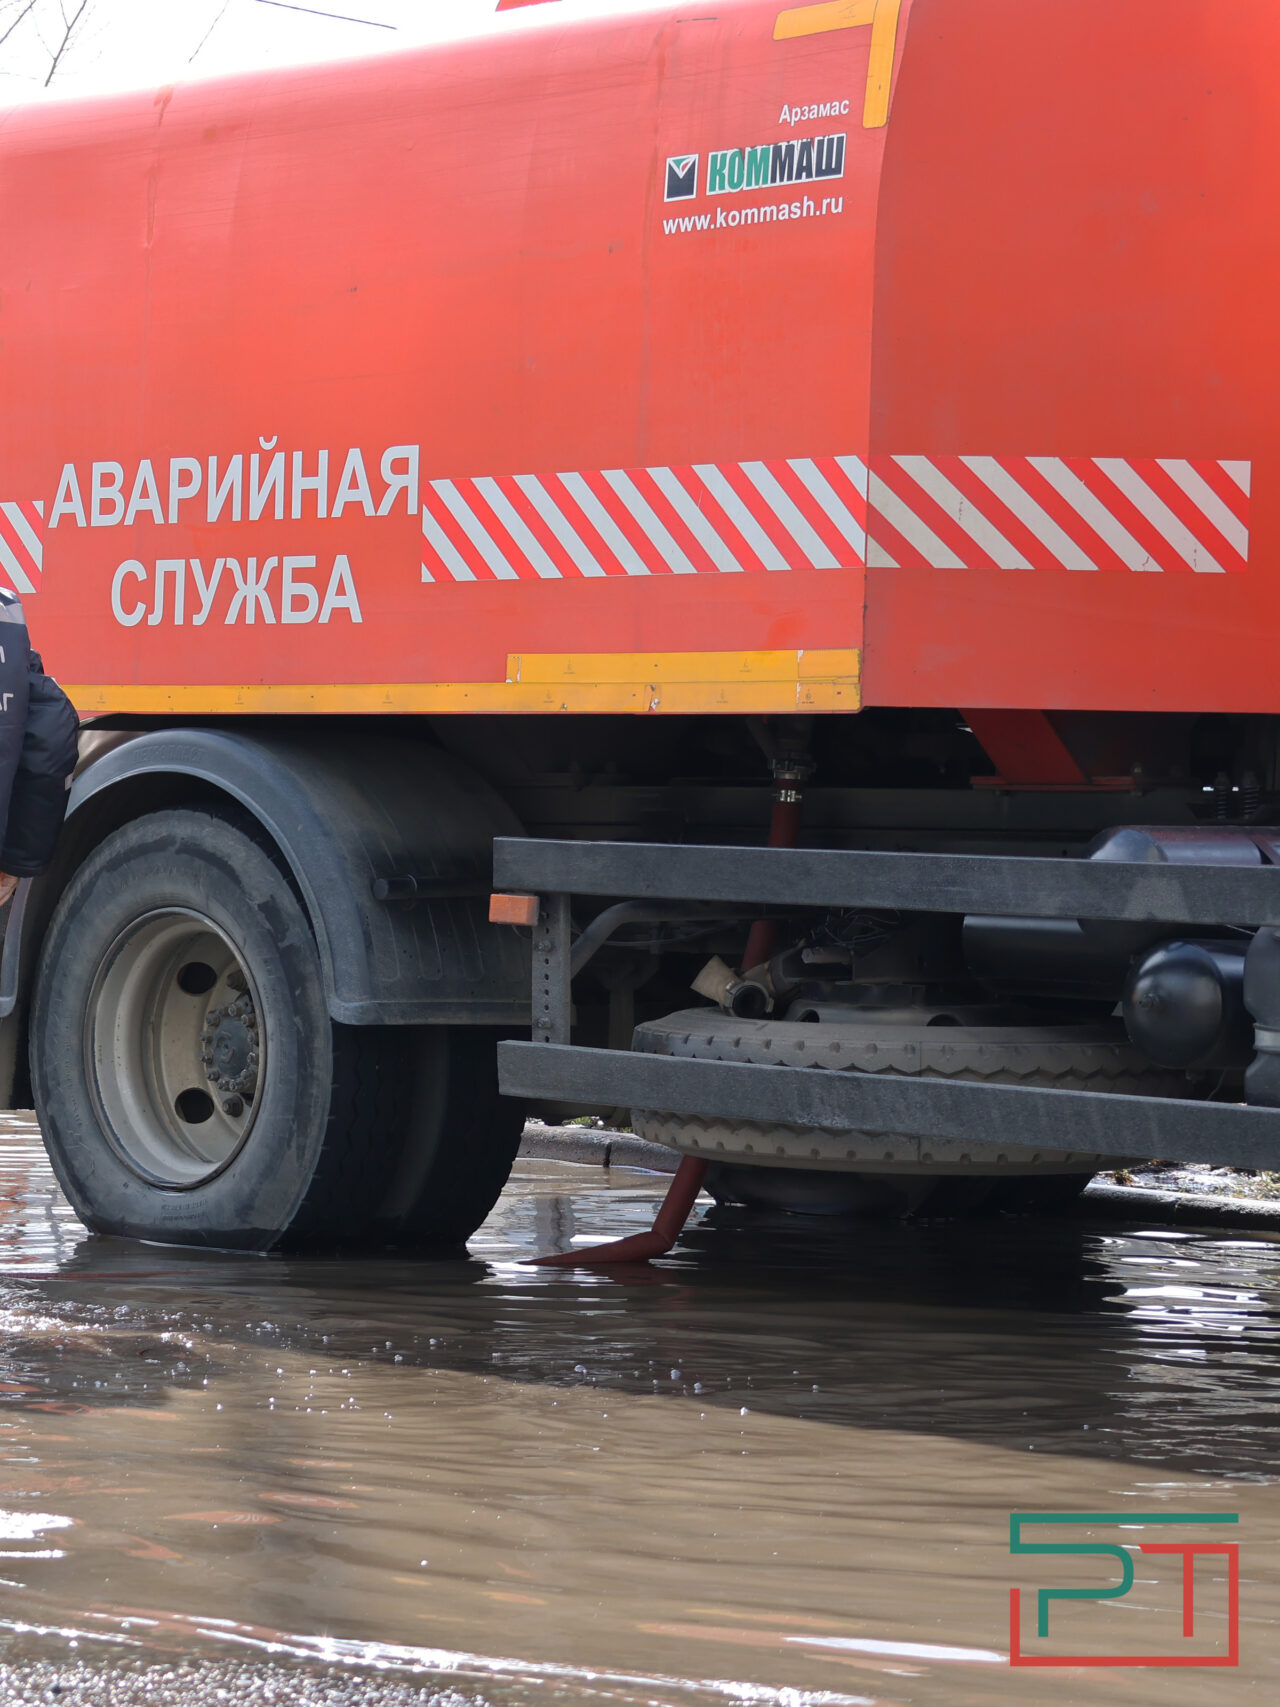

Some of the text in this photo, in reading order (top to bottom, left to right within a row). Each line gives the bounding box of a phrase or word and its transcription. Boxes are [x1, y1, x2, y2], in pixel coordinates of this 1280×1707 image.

[779, 100, 850, 126] Арзамас
[707, 133, 846, 195] КОММАШ
[662, 196, 843, 235] www.kommash.ru
[48, 435, 420, 528] АВАРИЙНАЯ
[111, 554, 363, 626] СЛУЖБА
